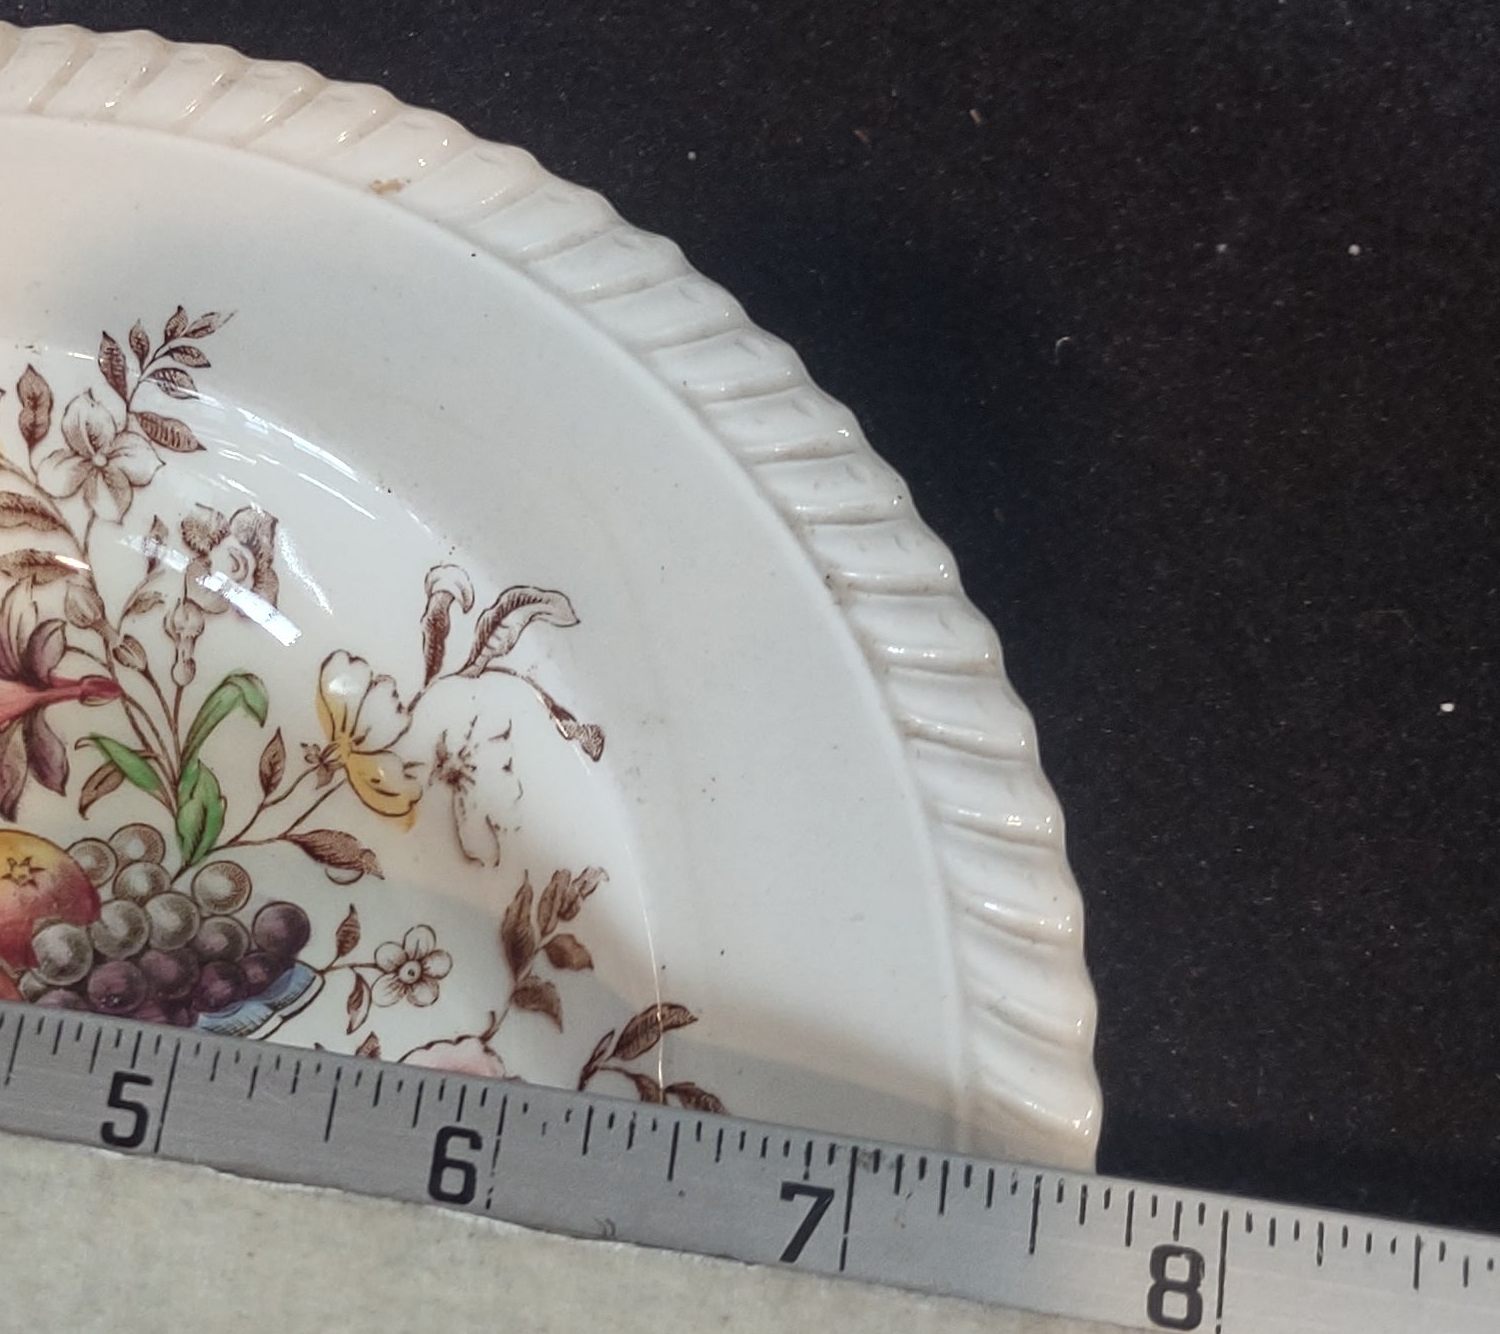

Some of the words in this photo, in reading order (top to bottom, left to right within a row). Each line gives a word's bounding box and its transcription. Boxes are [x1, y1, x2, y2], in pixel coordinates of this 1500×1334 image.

[101, 1070, 154, 1149] 5
[427, 1125, 484, 1206] 6
[778, 1180, 836, 1264] 7
[1146, 1243, 1206, 1332] 8
